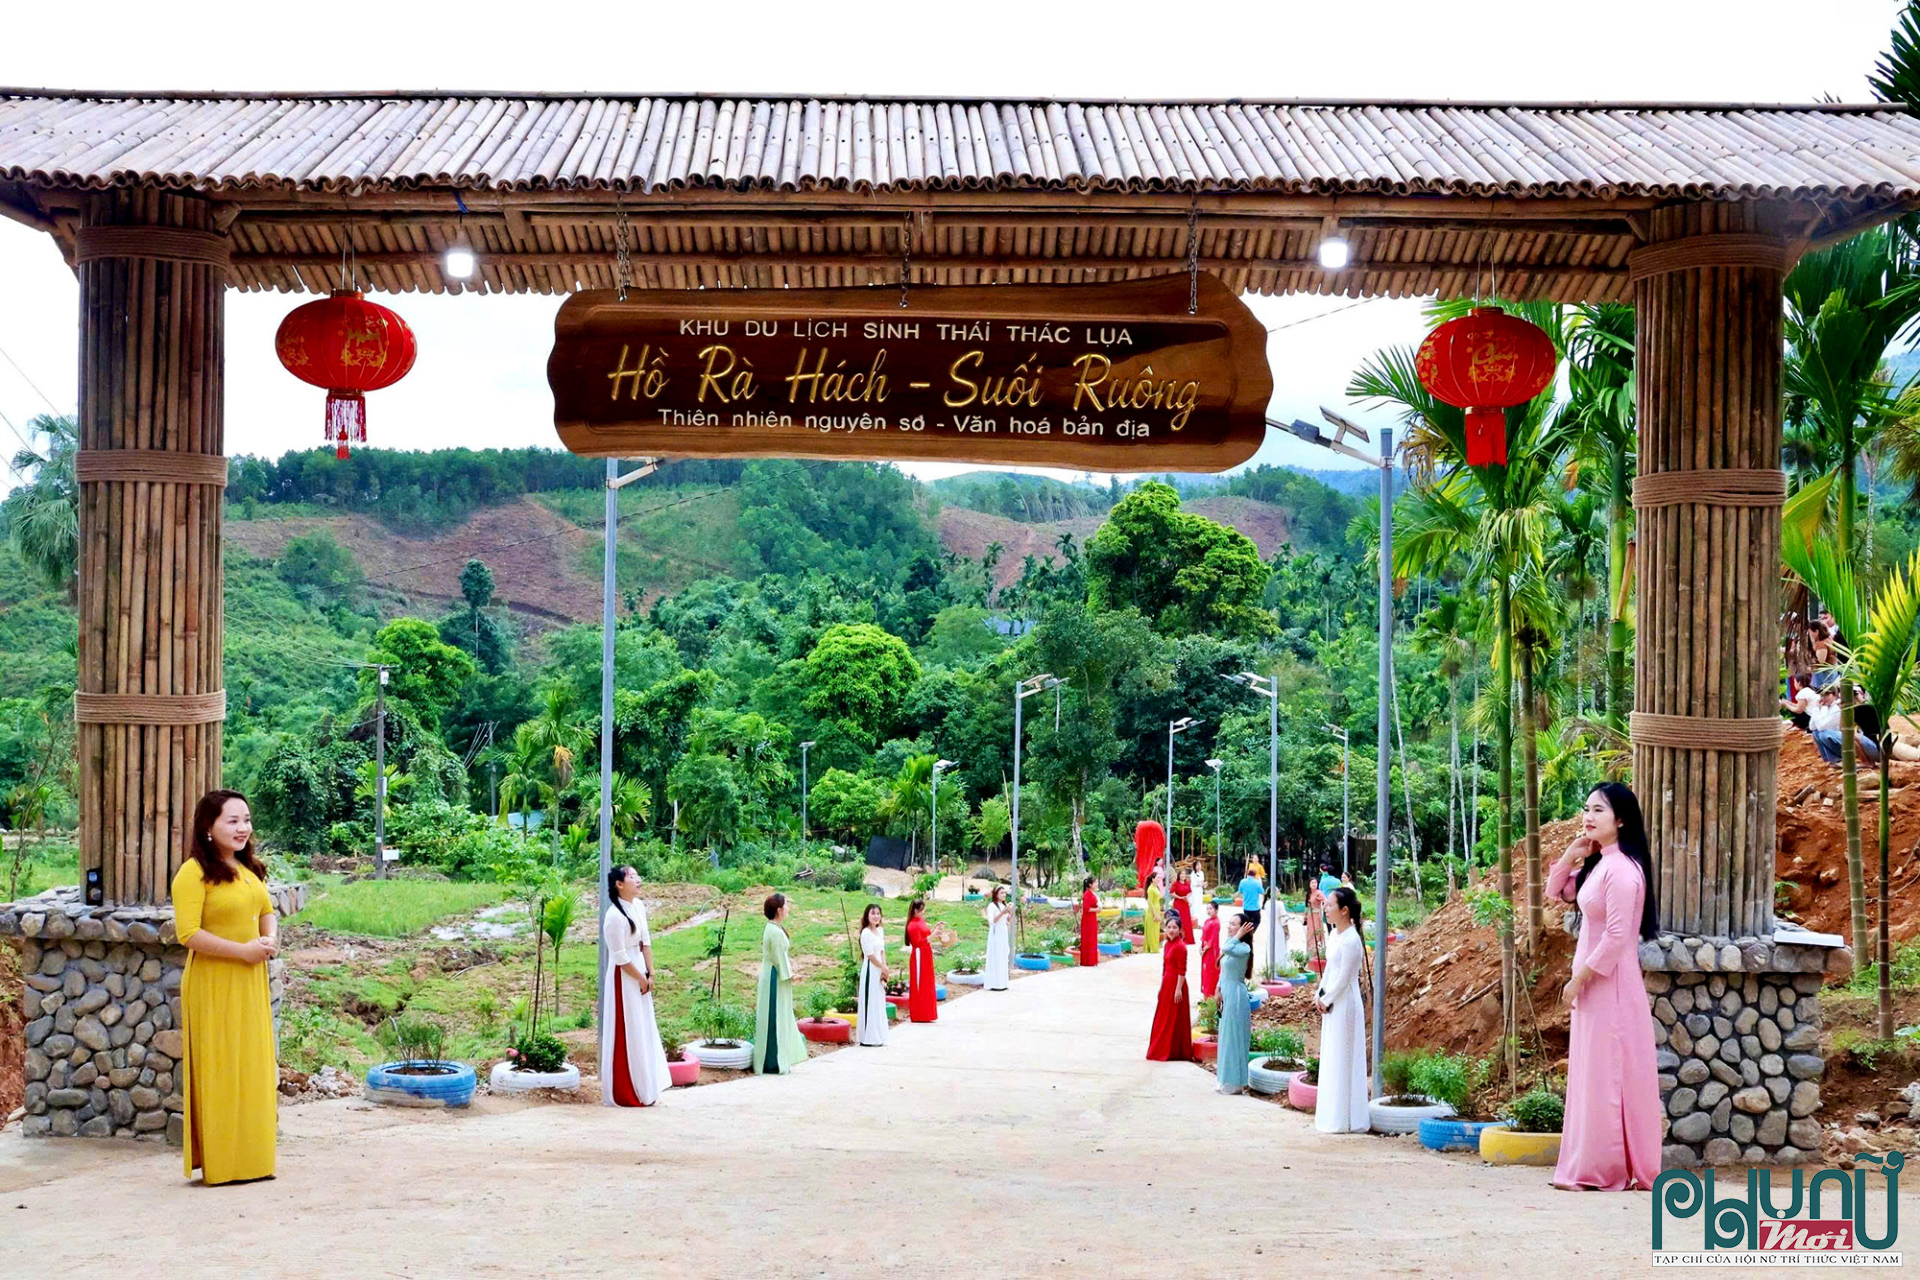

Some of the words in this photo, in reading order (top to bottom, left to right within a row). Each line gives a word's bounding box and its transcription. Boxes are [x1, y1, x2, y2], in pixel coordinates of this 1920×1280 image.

[680, 319, 729, 336] KHU
[745, 321, 778, 337] DU
[794, 319, 848, 340] LỊCH
[937, 321, 991, 342] THÁI
[1006, 322, 1071, 343] THÁC
[1085, 327, 1134, 348] LỤA
[607, 344, 671, 400] Hồ
[699, 345, 760, 403] Rà
[785, 347, 892, 403] Hách
[943, 351, 1043, 407] Suối
[658, 409, 719, 427] Thiên
[732, 411, 793, 428] nhiên
[805, 413, 887, 433] nguyên
[954, 415, 996, 433] Văn
[1009, 417, 1051, 435] hoá
[1063, 416, 1104, 436] bản
[1116, 419, 1151, 440] địa
